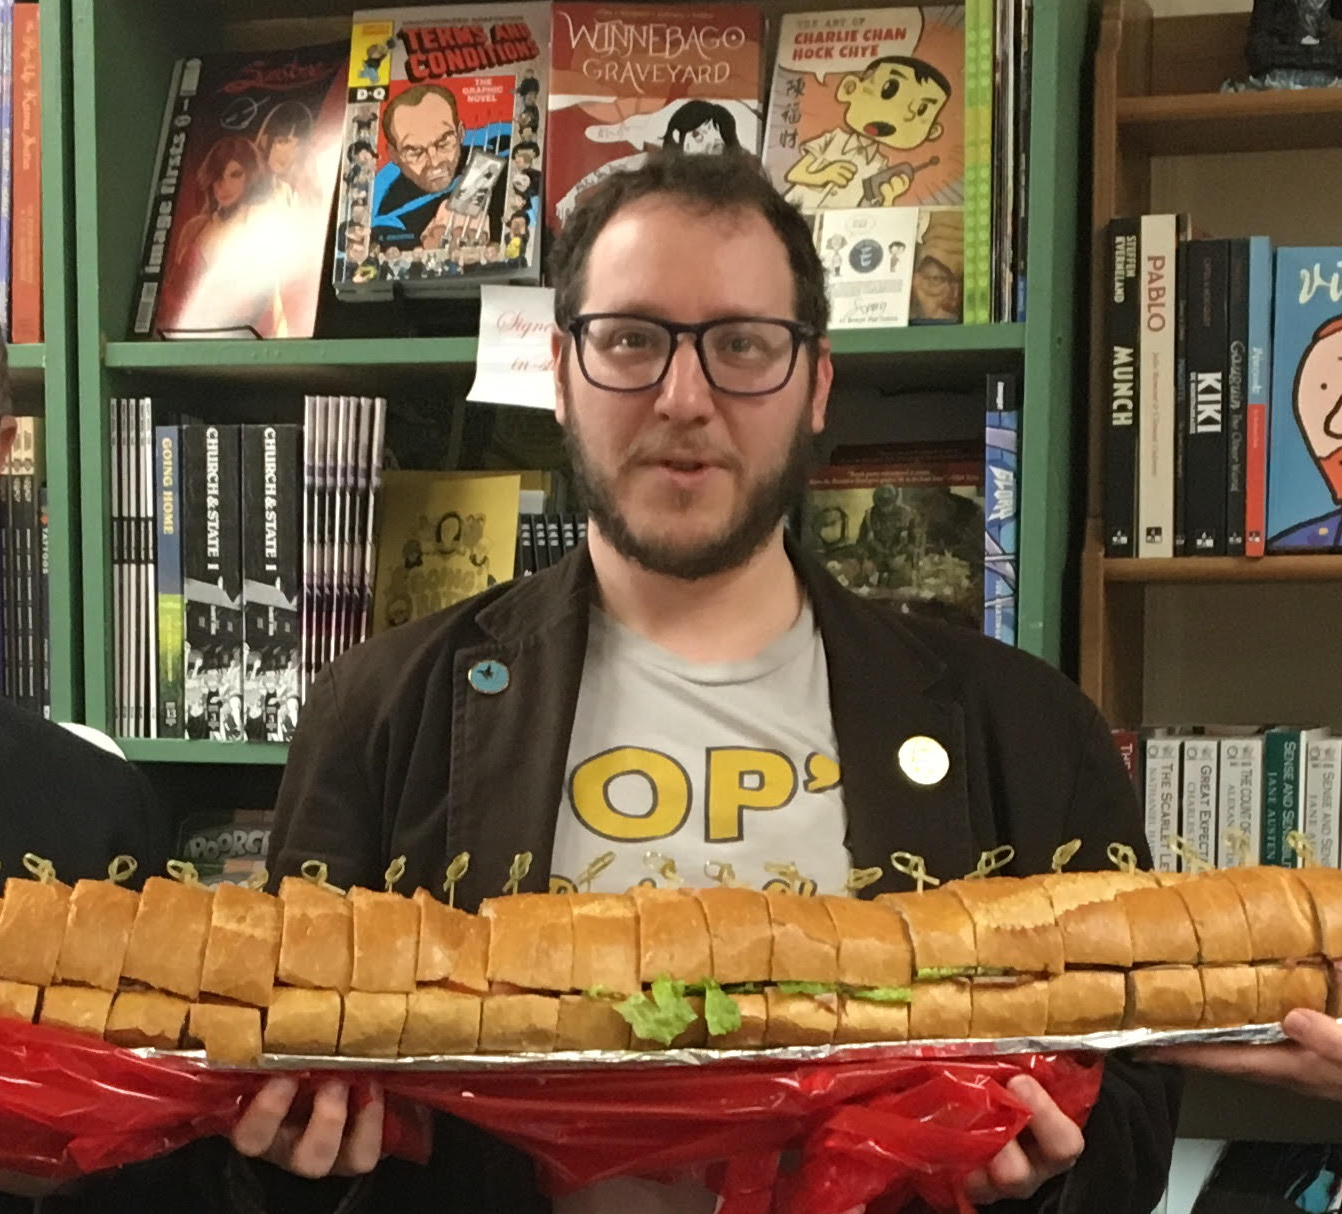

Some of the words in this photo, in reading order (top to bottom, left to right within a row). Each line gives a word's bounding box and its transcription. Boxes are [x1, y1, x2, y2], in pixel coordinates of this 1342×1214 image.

[404, 25, 489, 52] TERMS
[491, 22, 532, 43] AND
[558, 12, 746, 61] WINNEBAGO
[793, 31, 854, 46] CHARLIE
[856, 27, 907, 44] CHAN
[797, 18, 818, 29] THE
[822, 17, 848, 29] ART
[407, 40, 540, 80] CONDITIONS
[792, 46, 833, 61] HOCK
[836, 44, 879, 58] CHYE
[462, 86, 504, 95] GRAPHIC
[475, 78, 493, 86] THE
[582, 57, 731, 94] GRAVEYARD
[1146, 255, 1166, 332] PABLO
[1112, 346, 1134, 426] MUNCH
[1197, 372, 1222, 433] KIKI
[162, 438, 172, 485] GOING
[163, 491, 175, 536] HOME
[1161, 764, 1174, 785] THE
[1241, 769, 1253, 789] THE
[1283, 741, 1297, 780] SENSE
[1200, 765, 1212, 806] GREAT
[1267, 772, 1278, 805] JANE
[1282, 782, 1295, 808] AND
[1322, 771, 1335, 810] SENSE
[1160, 788, 1173, 842] SCARLET
[1240, 791, 1252, 821] COUNT
[1321, 812, 1333, 836] AND
[1265, 809, 1277, 860] AUSTEN
